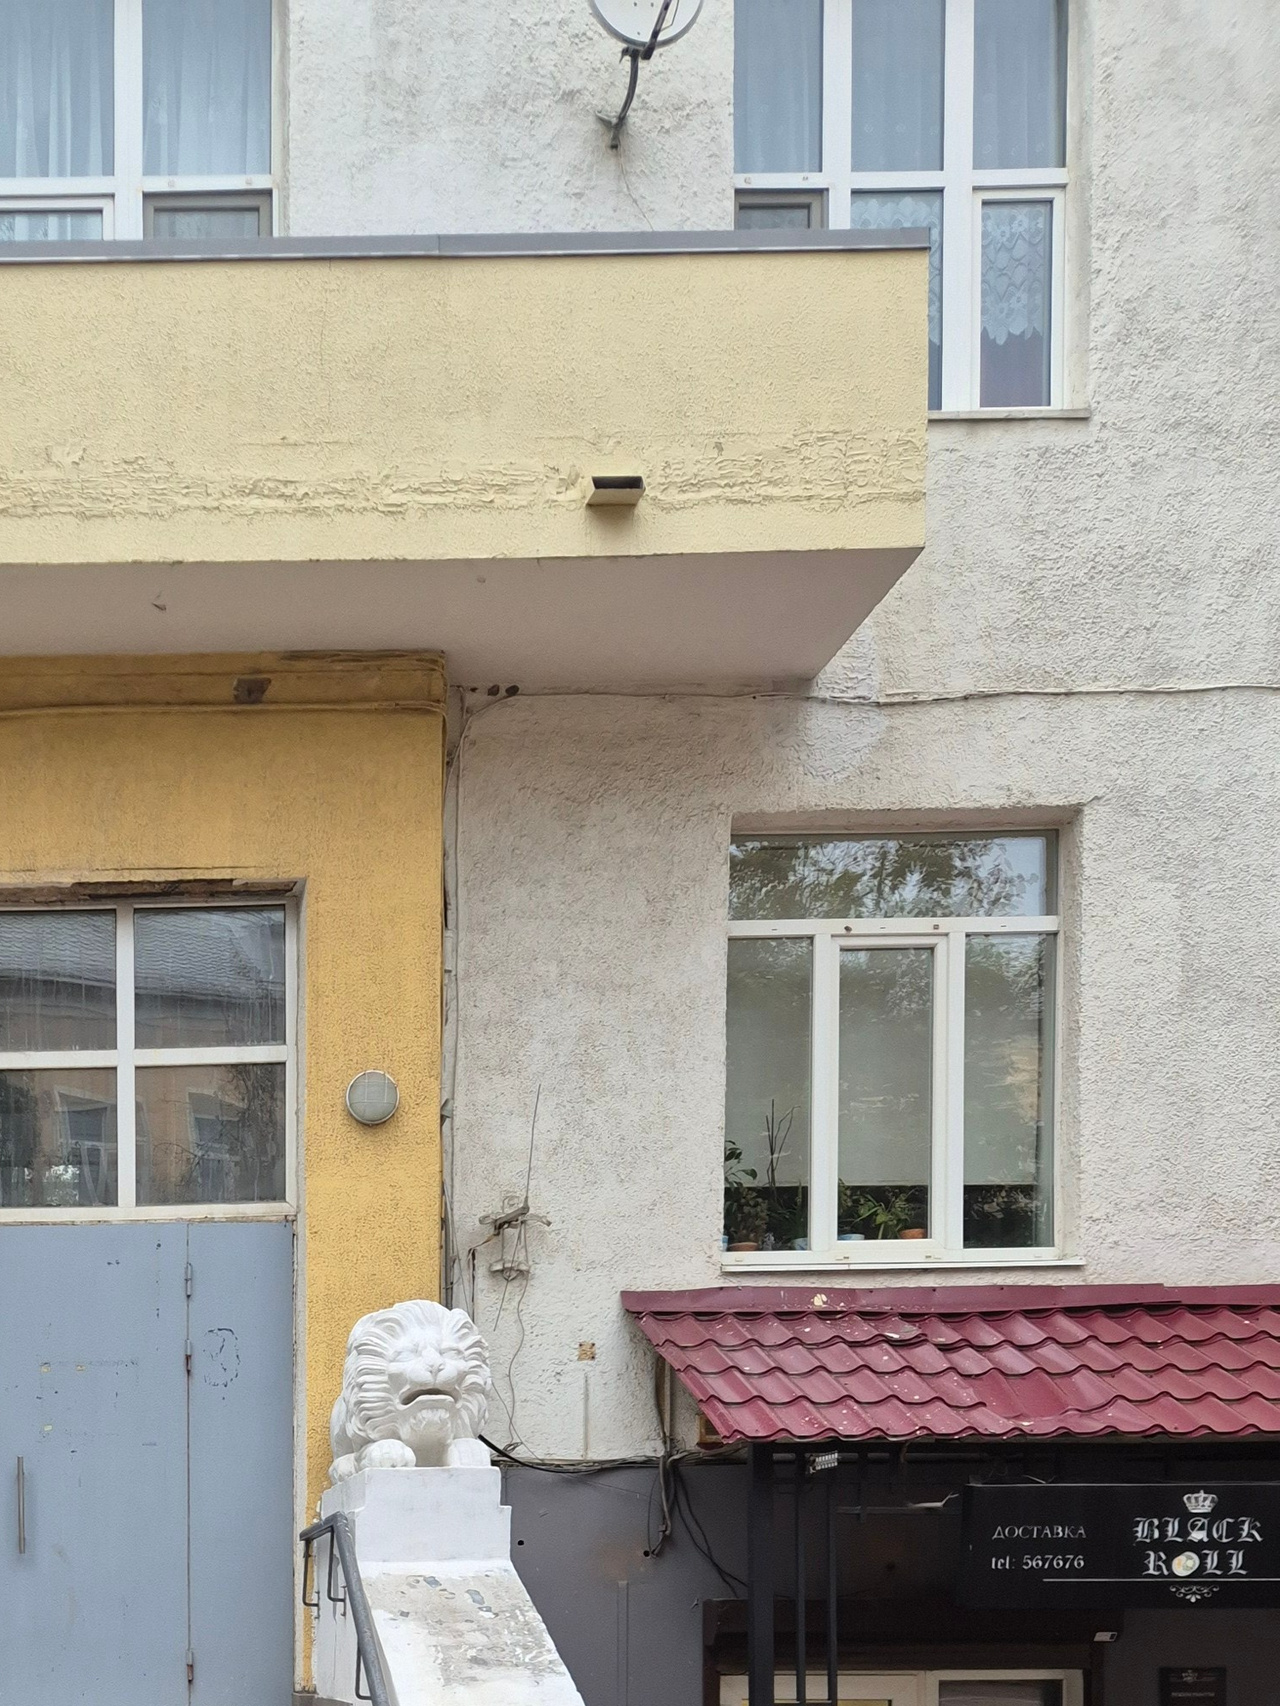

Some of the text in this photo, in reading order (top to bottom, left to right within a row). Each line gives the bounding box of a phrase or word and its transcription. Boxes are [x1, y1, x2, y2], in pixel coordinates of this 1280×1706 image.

[991, 1525, 1087, 1540] ДОСТАВКА
[1133, 1517, 1264, 1543] BLACK
[991, 1554, 1085, 1570] tel: 567676
